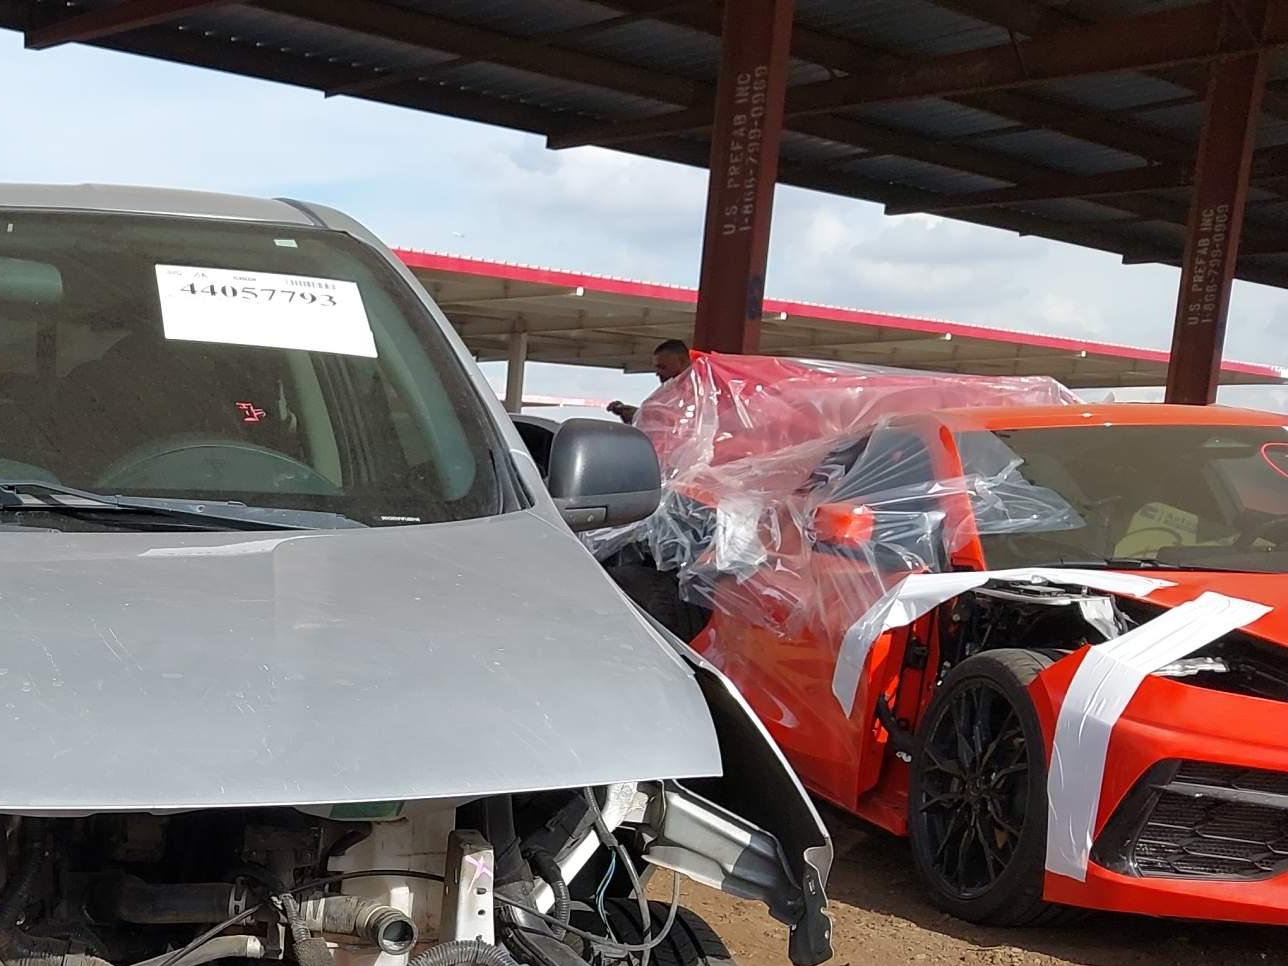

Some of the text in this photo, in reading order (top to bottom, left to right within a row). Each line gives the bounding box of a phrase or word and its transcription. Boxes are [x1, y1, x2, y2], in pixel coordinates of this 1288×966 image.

[735, 72, 751, 104] INC
[727, 113, 748, 188] PREFAB
[1187, 208, 1214, 326] U.S. PREFAB INC
[180, 282, 337, 307] 44057793
